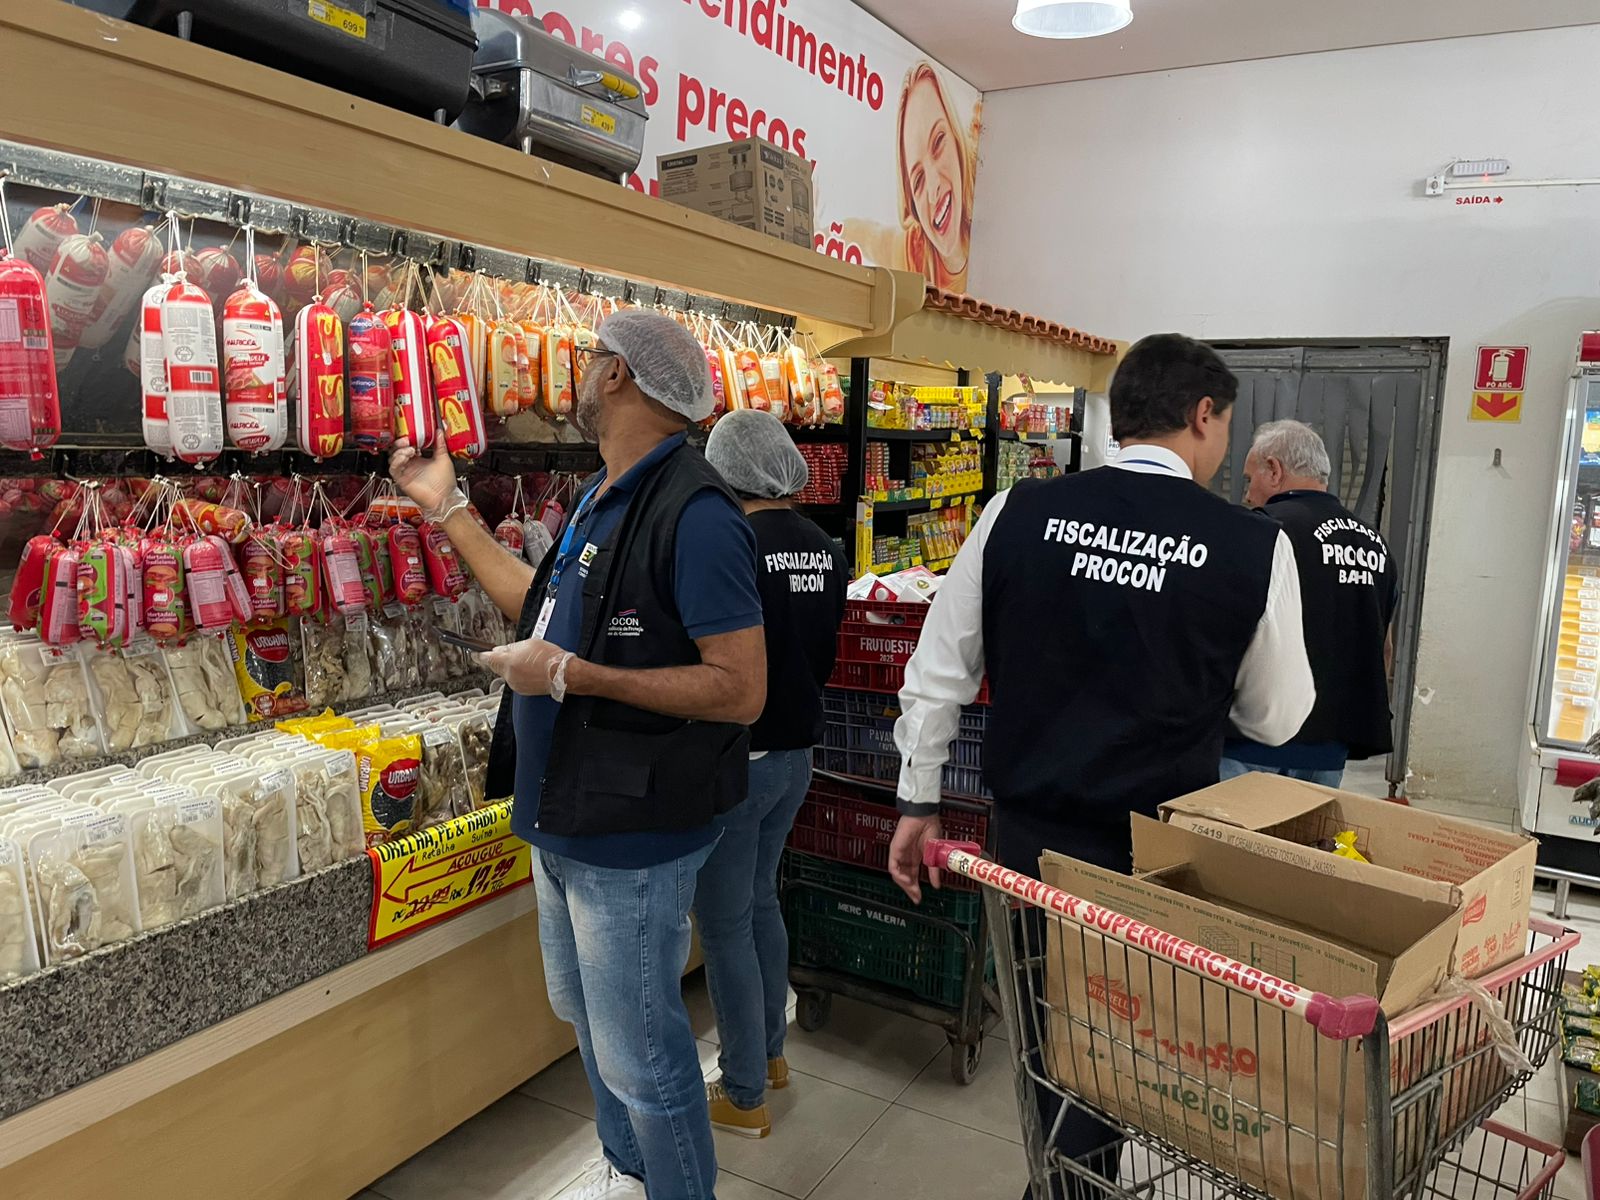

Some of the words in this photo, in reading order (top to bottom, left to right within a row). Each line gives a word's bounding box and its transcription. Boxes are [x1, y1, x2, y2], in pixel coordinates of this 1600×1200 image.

[343, 19, 358, 33] 699
[684, 0, 884, 111] endimento
[1456, 195, 1490, 205] SAÍDA
[1044, 518, 1208, 568] FISCALIZAÇÃO
[1070, 552, 1167, 592] PROCON
[608, 617, 639, 626] OCON
[253, 633, 288, 648] URBANO
[860, 637, 916, 655] FRUTOESTE
[359, 755, 373, 792] URBANO
[448, 842, 503, 872] AÇOUGUE
[1191, 823, 1223, 839] 75419
[1253, 842, 1278, 858] CRACKER
[1280, 849, 1311, 868] TOSTADINHA
[838, 902, 862, 916] MERC
[866, 909, 907, 928] VALERIA
[1083, 903, 1301, 1008] SUPERMERCADOS
